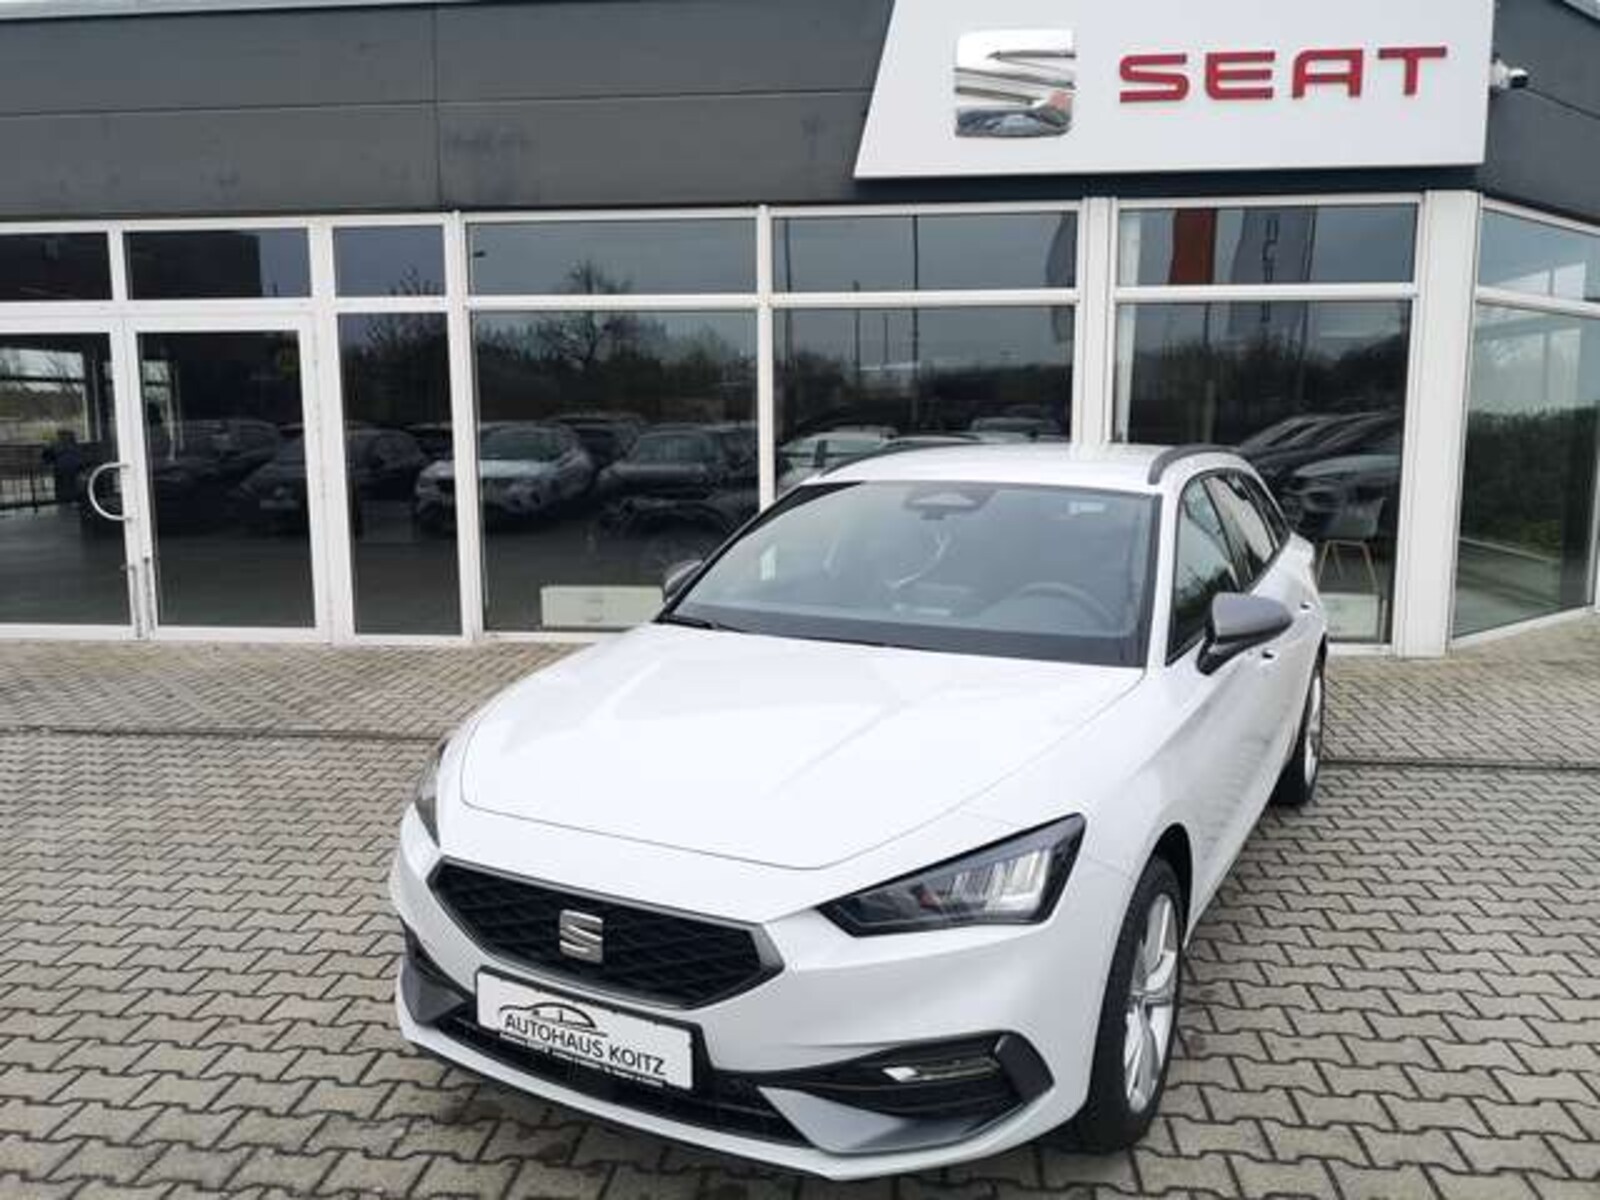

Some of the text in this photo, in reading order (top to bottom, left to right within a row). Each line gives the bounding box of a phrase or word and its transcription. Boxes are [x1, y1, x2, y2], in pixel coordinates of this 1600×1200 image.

[1119, 45, 1448, 104] SEAT
[505, 1013, 604, 1059] AUTOHAUS
[609, 1043, 667, 1076] KOITZ
